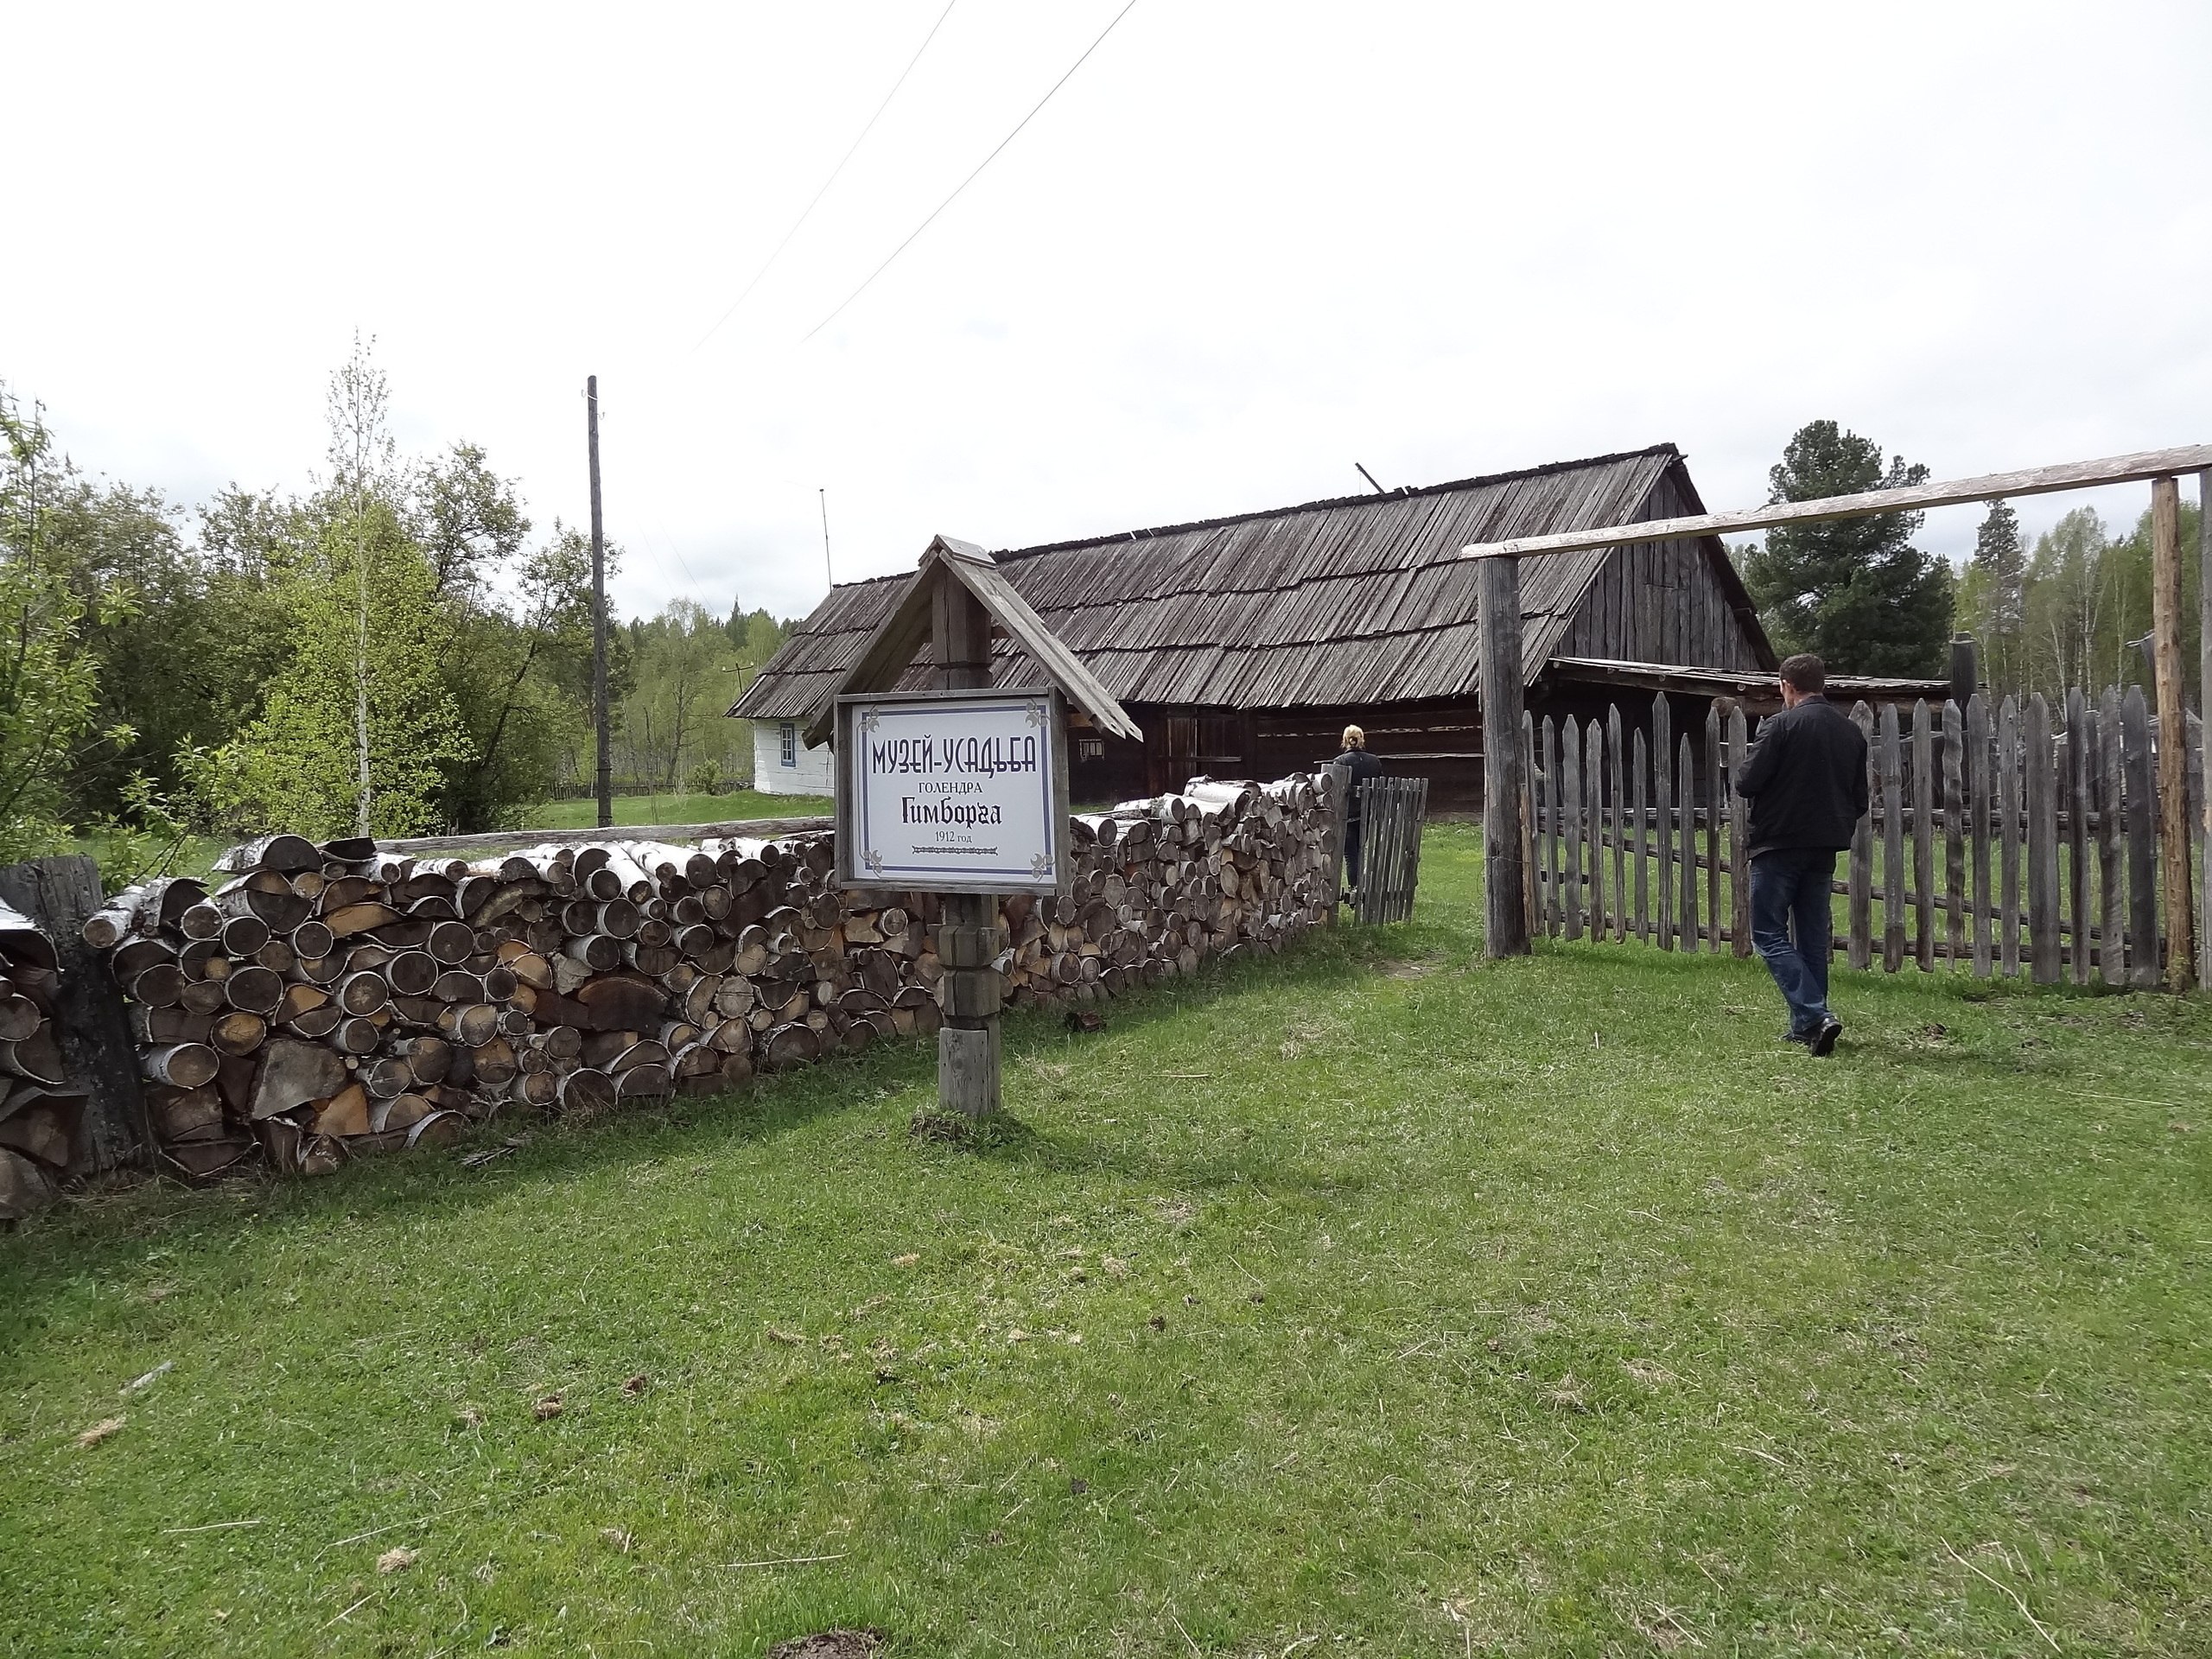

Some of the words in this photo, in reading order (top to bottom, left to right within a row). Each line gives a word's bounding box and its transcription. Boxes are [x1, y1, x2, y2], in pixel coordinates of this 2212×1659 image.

[873, 734, 1037, 779] МУЗЕЙ-УСАДЬБА
[918, 781, 983, 795] ГОЛЕНДРА
[901, 796, 1002, 830] Гимборга
[935, 831, 956, 842] 1912
[957, 835, 973, 844] год
